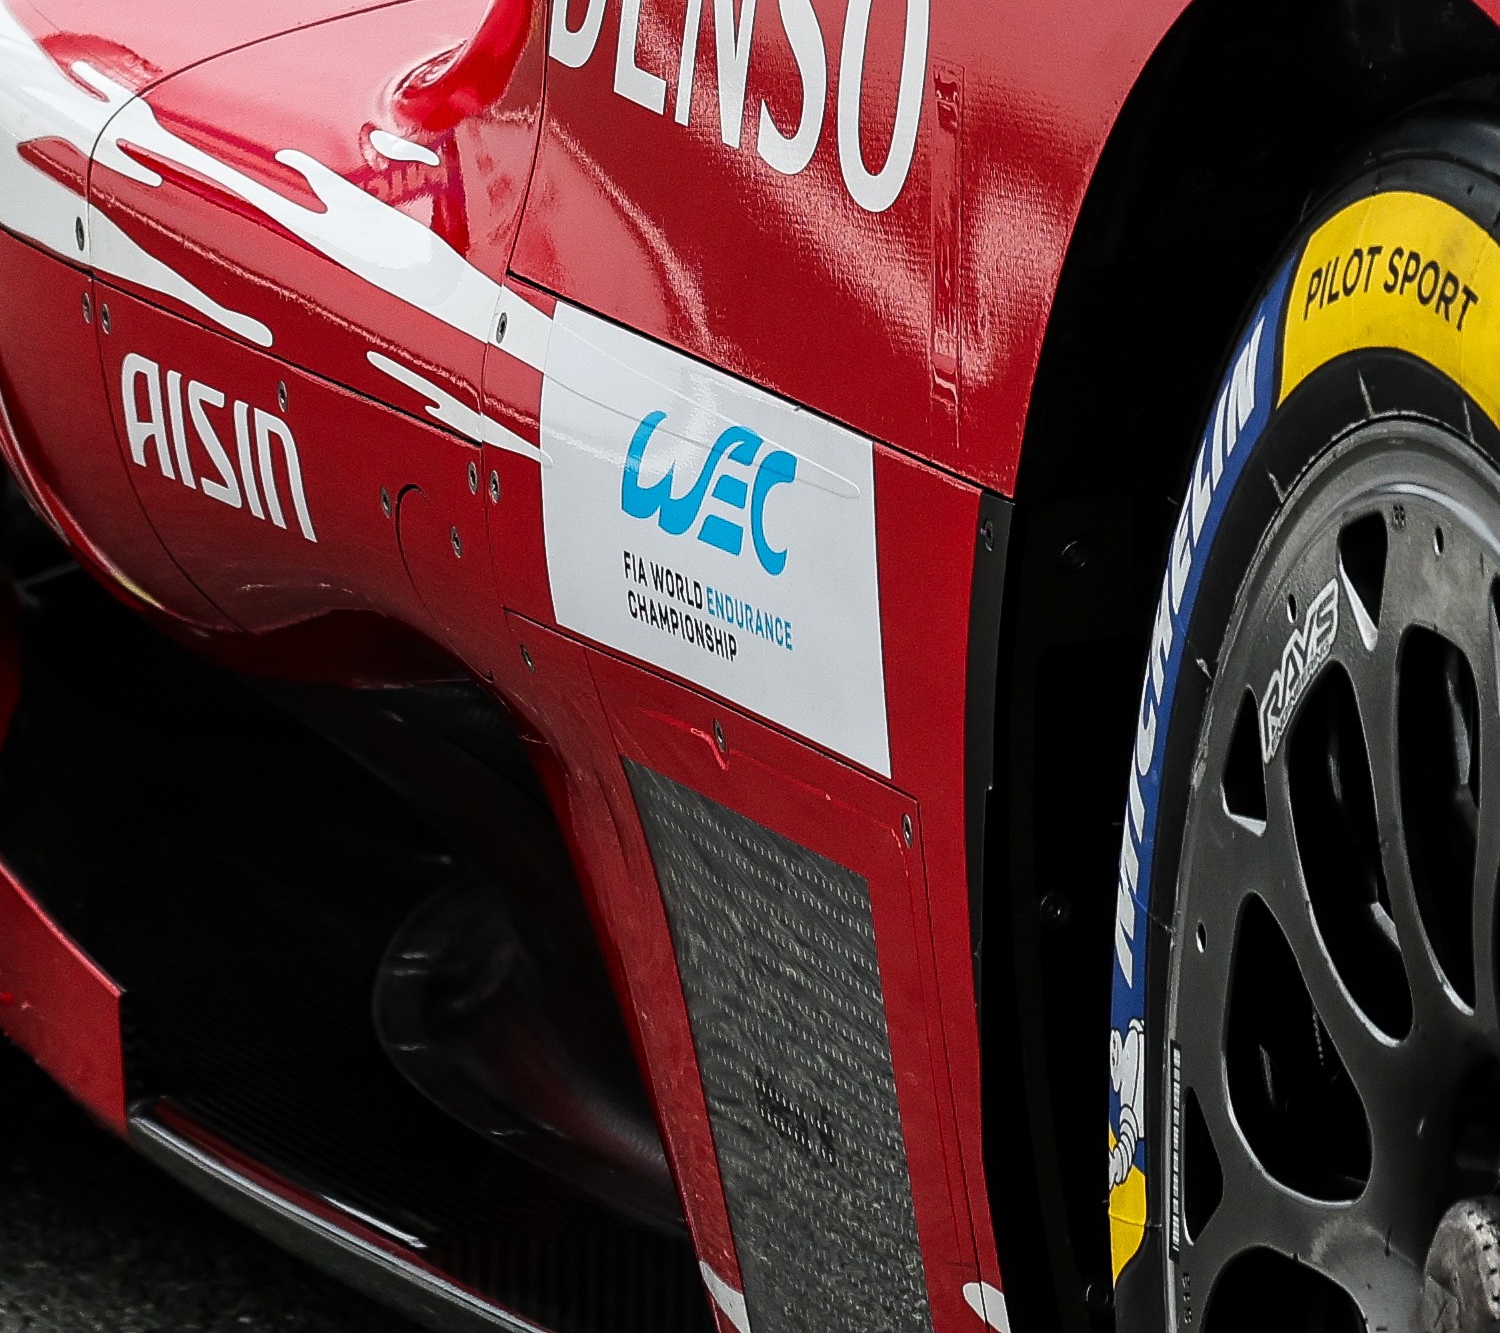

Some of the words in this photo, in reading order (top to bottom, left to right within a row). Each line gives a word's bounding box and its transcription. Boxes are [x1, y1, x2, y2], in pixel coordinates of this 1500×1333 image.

[1302, 244, 1383, 323] PILOT
[1382, 246, 1480, 332] SPORT
[121, 351, 319, 544] AISIN
[619, 408, 797, 578] WEC
[623, 549, 649, 587] FIA
[649, 560, 704, 611] WORLD
[705, 585, 794, 651] ENDURANCE
[627, 589, 738, 663] CHAMPIONSHIP
[1112, 316, 1266, 990] MICHELIN
